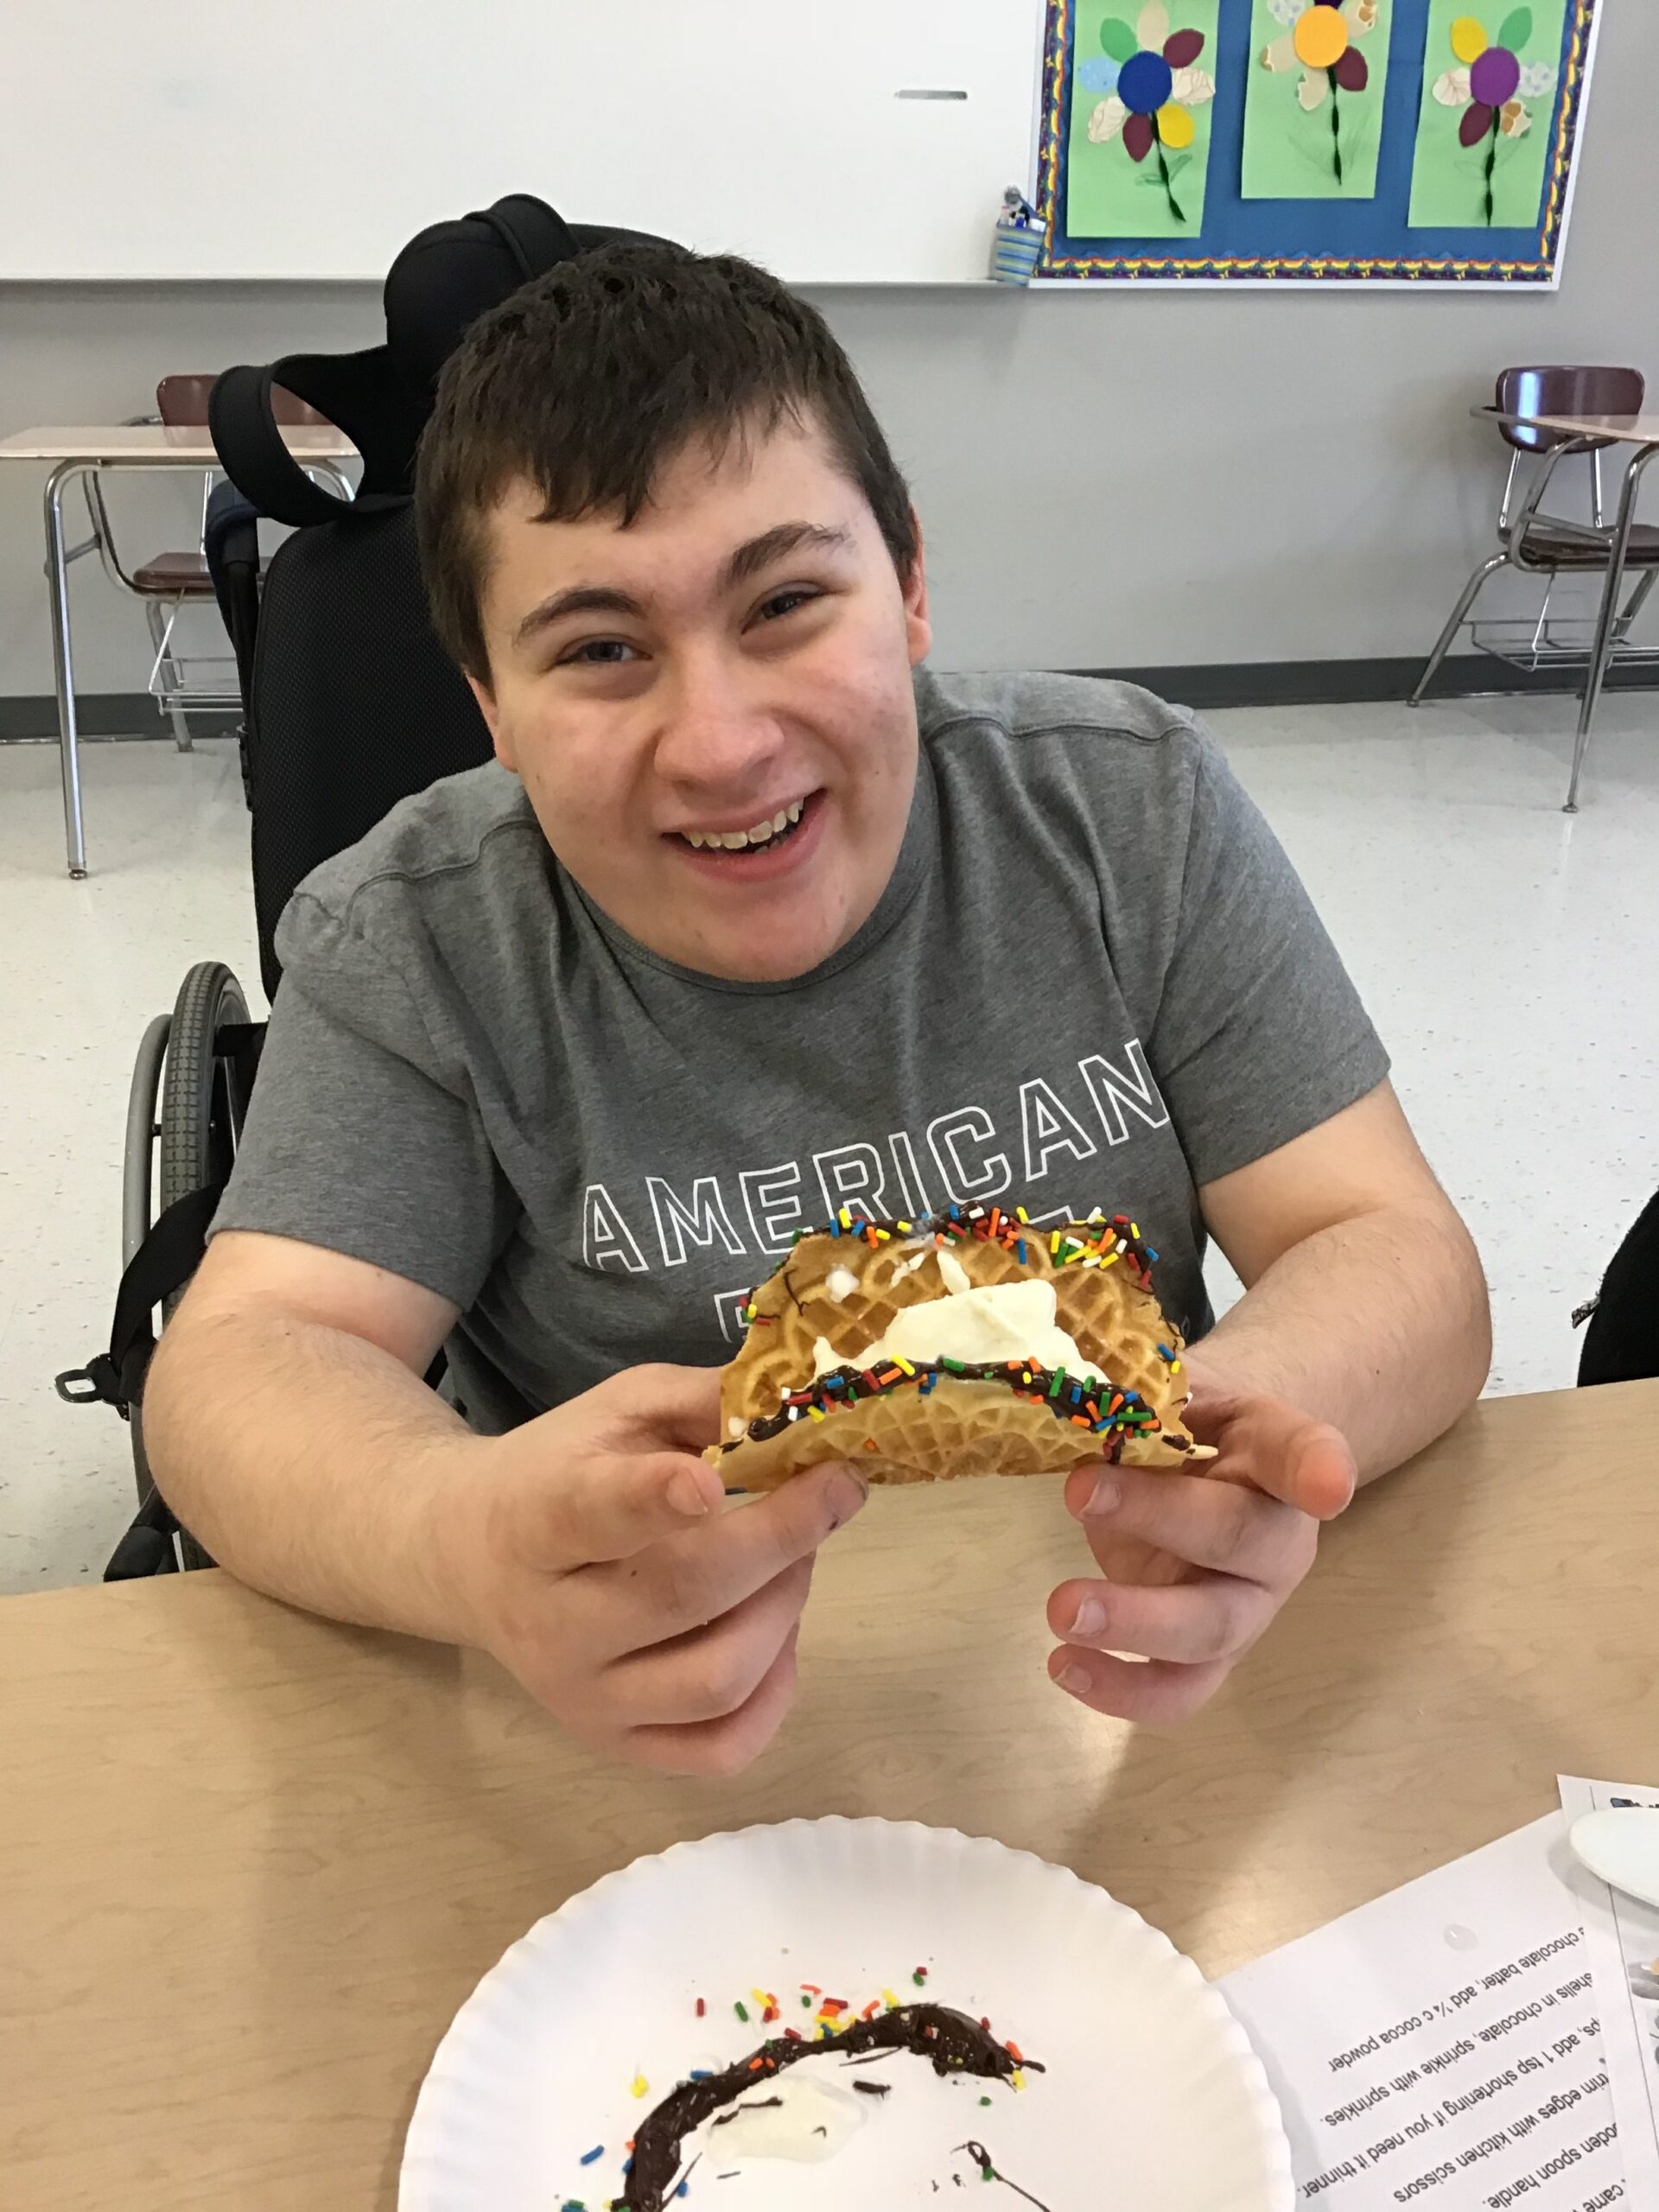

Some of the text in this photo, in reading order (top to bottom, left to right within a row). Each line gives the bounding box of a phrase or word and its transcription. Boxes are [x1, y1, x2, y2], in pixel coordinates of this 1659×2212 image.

[582, 1039, 1171, 1272] AMERICAN
[1518, 1932, 1580, 1968] chocolate
[1475, 1964, 1523, 1990] batter,
[1450, 1986, 1478, 2009] add
[1422, 2010, 1434, 2021] c
[1379, 2017, 1422, 2044] cocoa
[1320, 1973, 1592, 2126] shells in chocolate, sprinkle with sprinkles.
[1328, 2036, 1381, 2073] powder
[1541, 2051, 1554, 2064] 1
[1552, 2034, 1580, 2057] add
[1517, 2056, 1545, 2075] tsp
[1442, 2069, 1518, 2116] shortening
[1537, 2089, 1582, 2119] edges
[1404, 2113, 1434, 2139] you
[1433, 2110, 1449, 2127] if
[1507, 2114, 1541, 2138] with
[1353, 2154, 1371, 2170] it
[1366, 2133, 1406, 2162] need
[1455, 2131, 1512, 2167] kitchen
[1297, 2161, 1358, 2198] thinner.
[1482, 2122, 1618, 2209] oden spoon handle.
[1393, 2161, 1457, 2202] scissors
[1582, 2183, 1624, 2212] came
